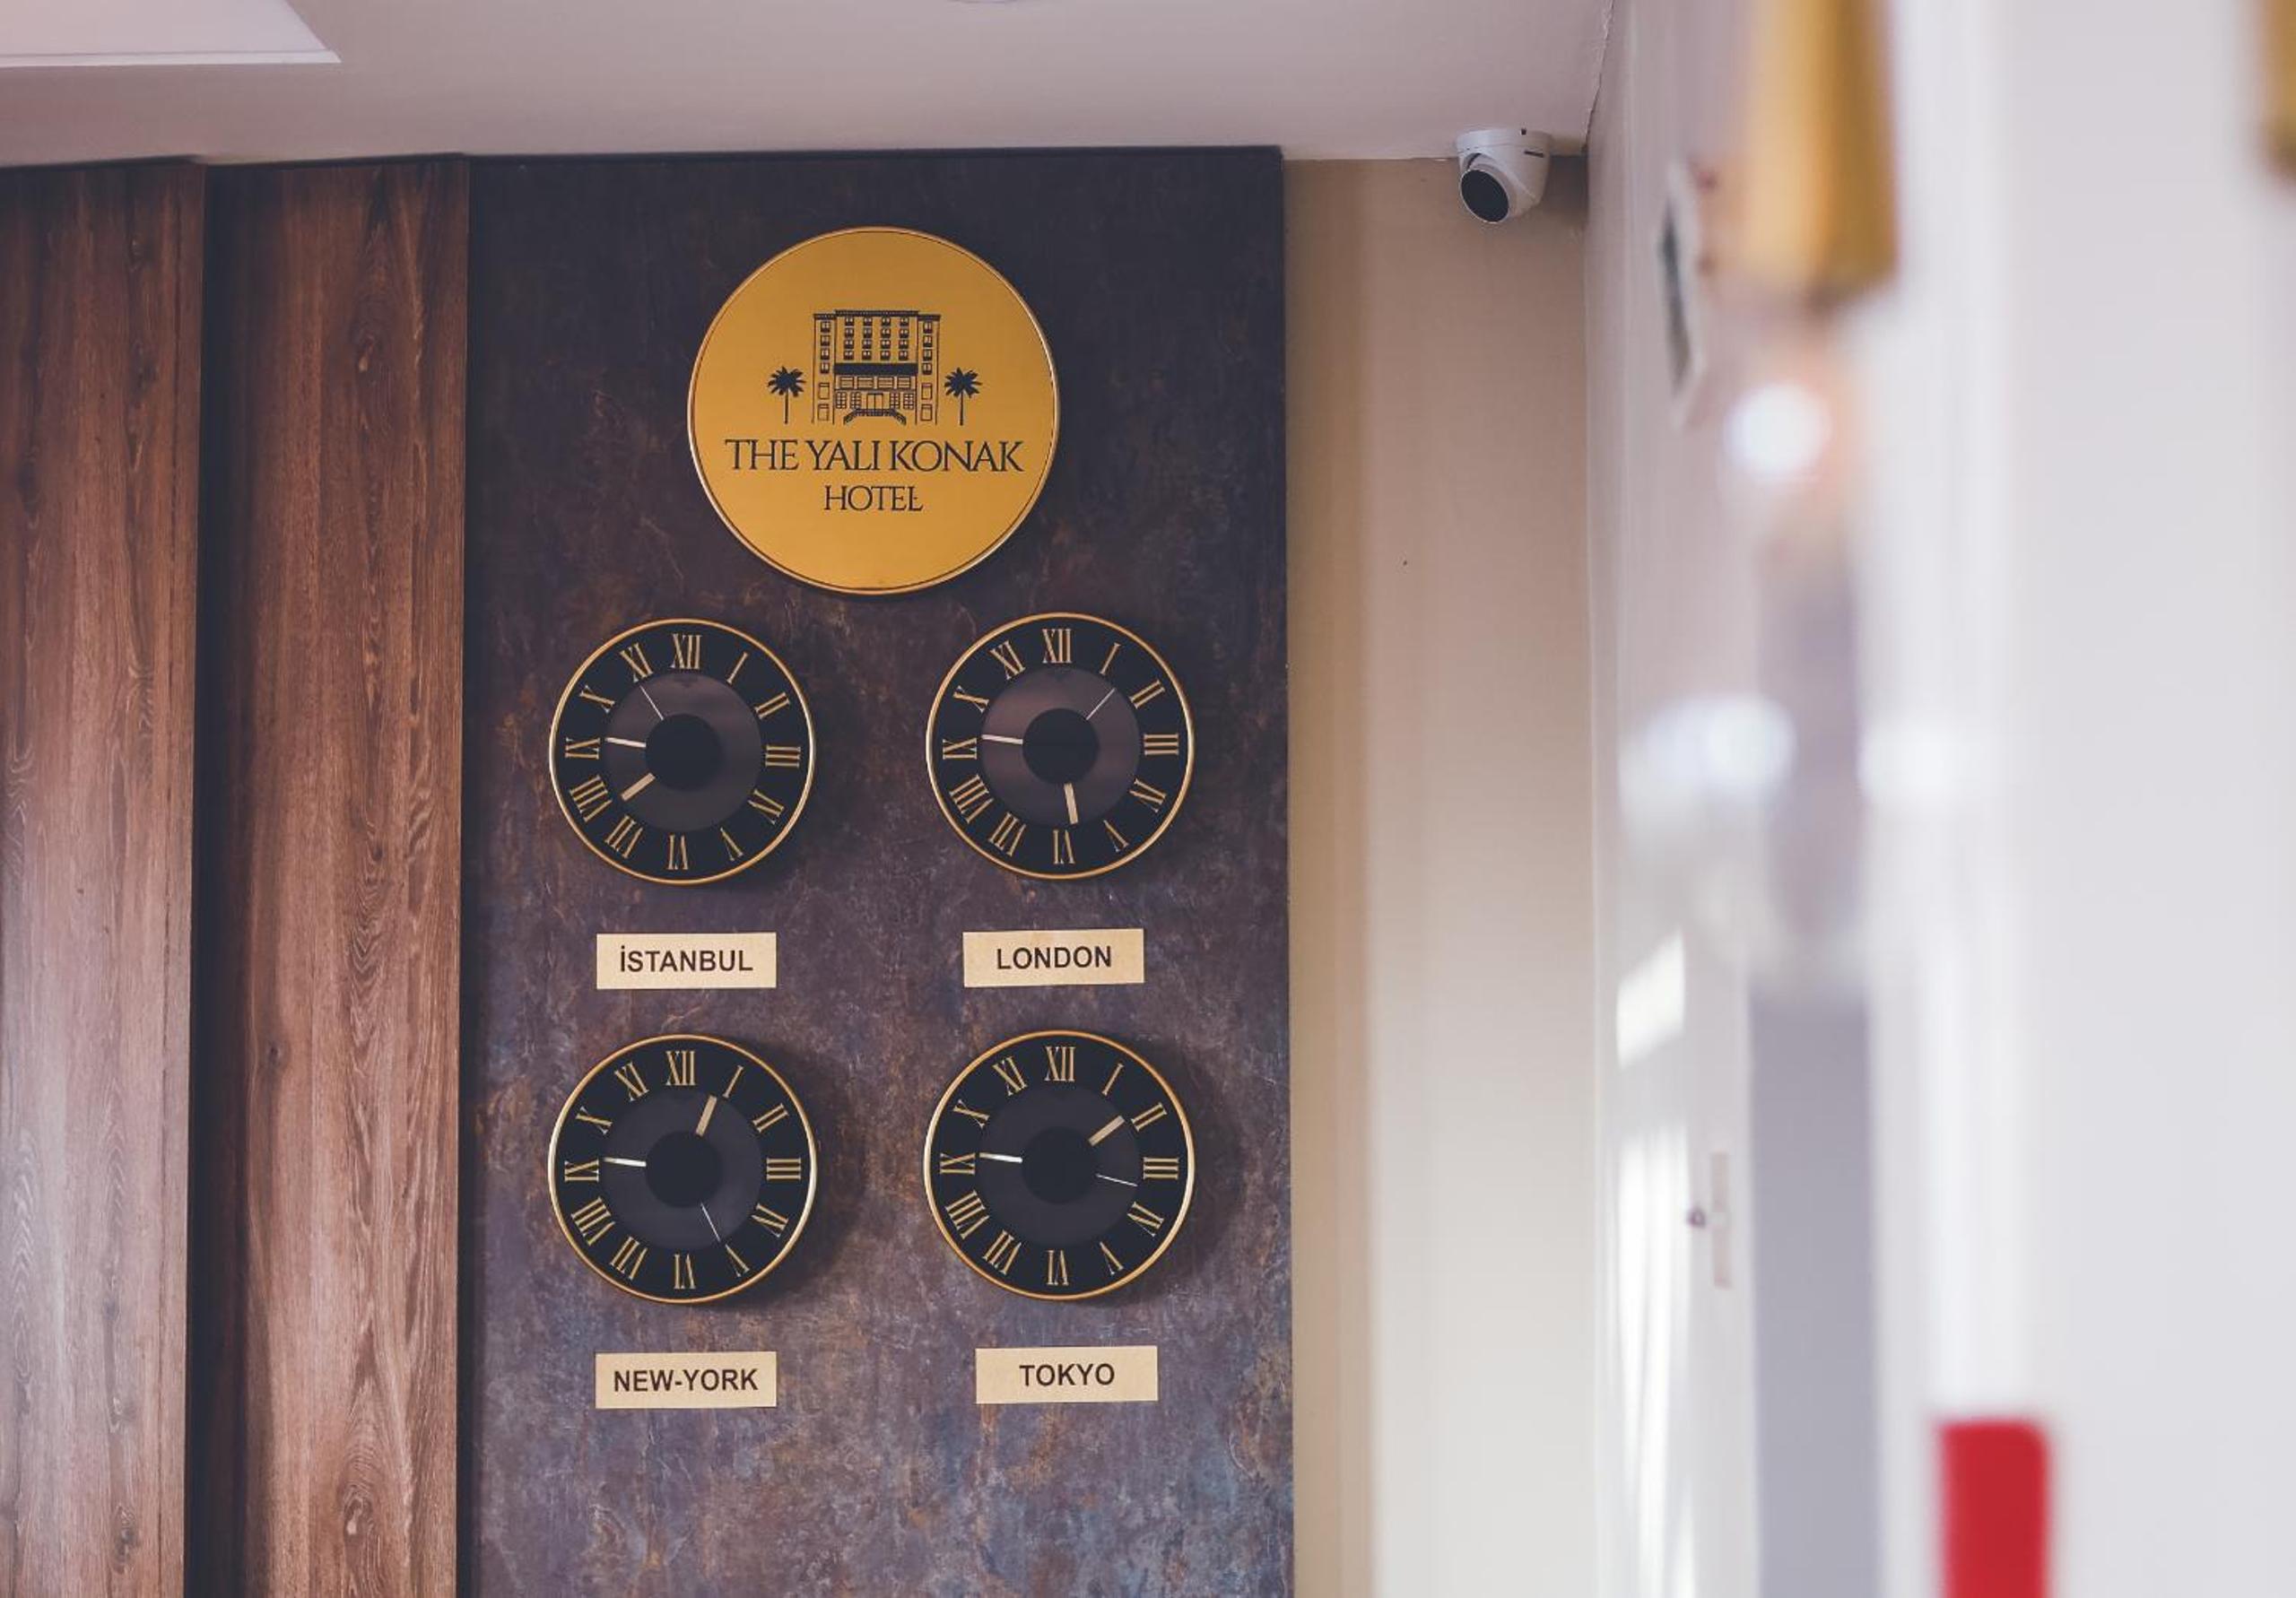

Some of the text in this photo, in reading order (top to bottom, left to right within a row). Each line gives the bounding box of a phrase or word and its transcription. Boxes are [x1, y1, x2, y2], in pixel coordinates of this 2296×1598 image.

[725, 439, 1024, 473] THE YALI KONAK
[823, 484, 924, 512] HOTEL
[670, 633, 702, 669] XII
[990, 640, 1026, 680] XI
[1042, 629, 1072, 664] XII
[1100, 642, 1121, 674] I
[619, 642, 654, 682] XI
[726, 651, 749, 684] I
[579, 685, 615, 714] X
[753, 692, 791, 719] II
[952, 685, 989, 713] X
[1130, 680, 1165, 708] II
[765, 745, 801, 768] III
[1144, 734, 1178, 755] III
[621, 945, 753, 972] İSTANBUL
[996, 945, 1112, 969] LONDON
[665, 1051, 696, 1085] XII
[992, 1056, 1027, 1096] XI
[1044, 1046, 1076, 1081] XII
[614, 1062, 649, 1101] XI
[723, 1065, 744, 1099] I
[1101, 1064, 1124, 1096] I
[576, 1107, 613, 1135] X
[752, 1103, 789, 1133] II
[953, 1099, 990, 1128] X
[1131, 1102, 1168, 1132] II
[766, 1158, 801, 1180] III
[1143, 1157, 1178, 1179] III
[614, 1368, 759, 1392] NEW-YORK
[1019, 1363, 1115, 1386] TOKYO
